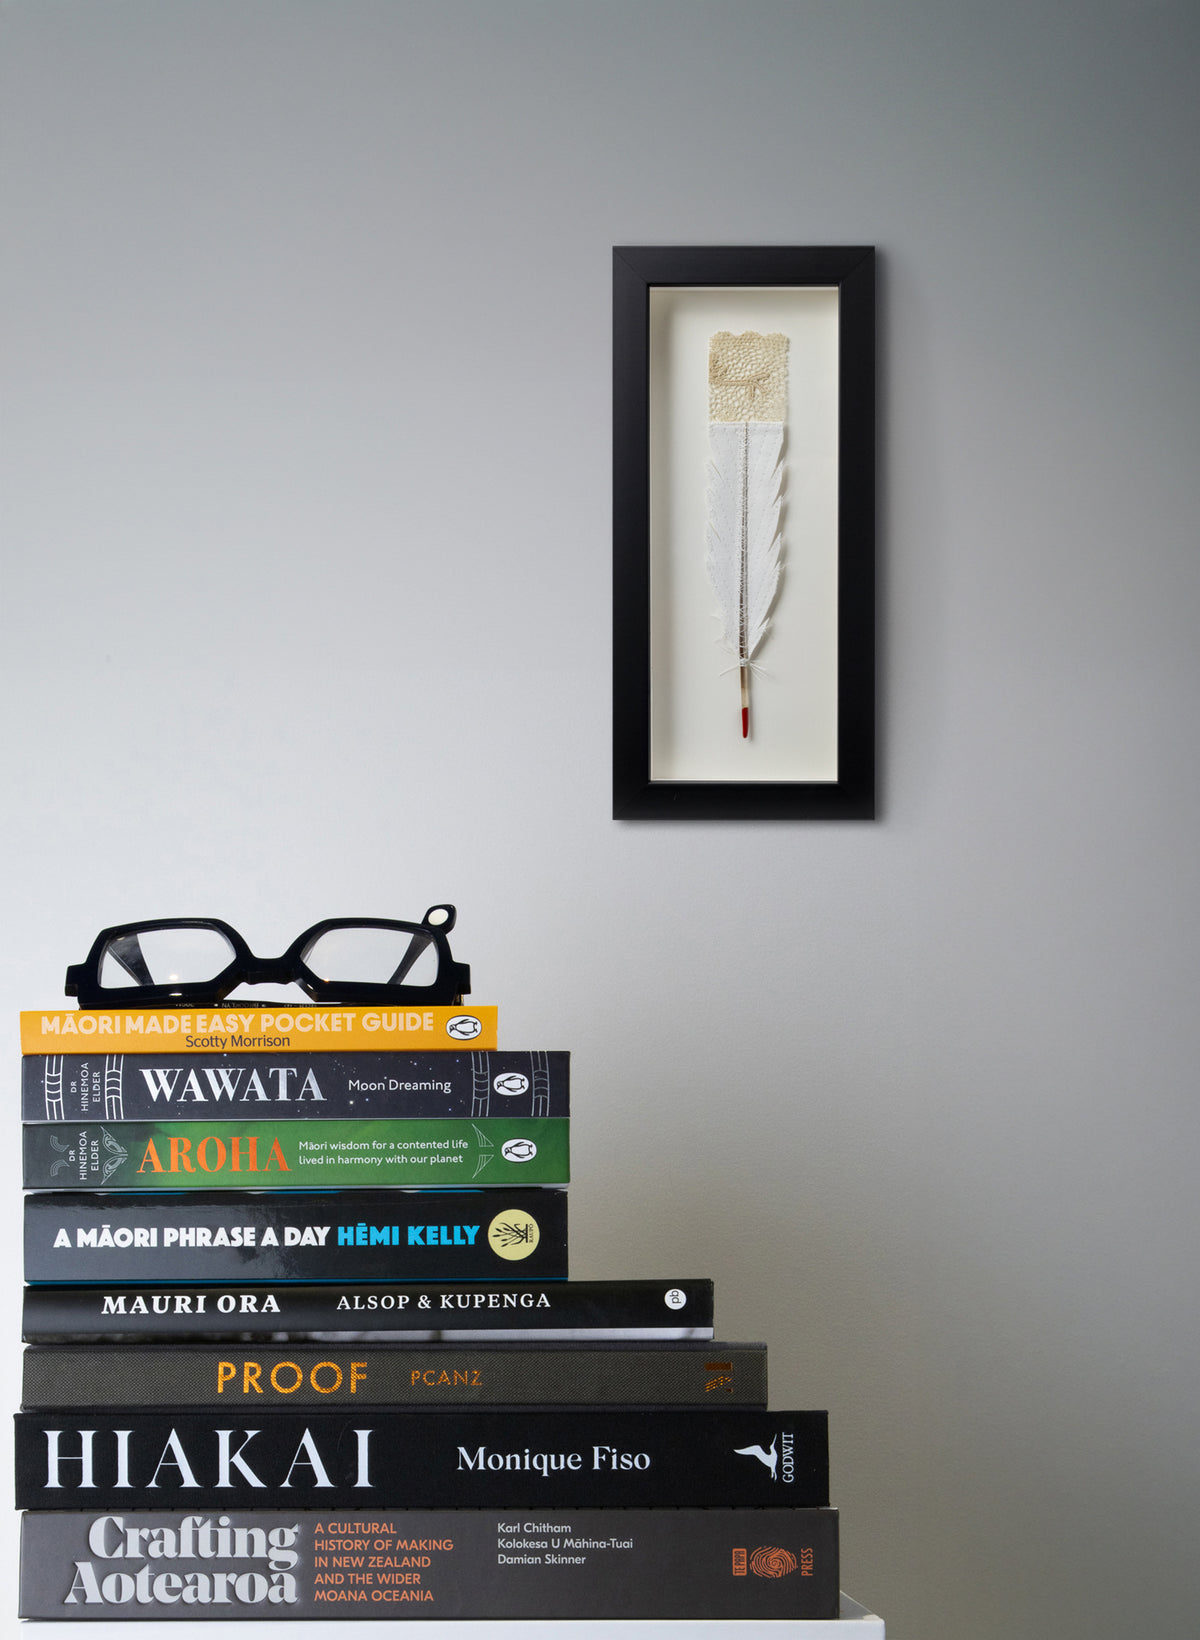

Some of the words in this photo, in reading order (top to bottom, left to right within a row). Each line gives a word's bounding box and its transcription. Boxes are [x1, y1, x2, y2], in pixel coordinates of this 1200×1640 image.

[41, 1012, 121, 1035] MĀORI
[125, 1015, 192, 1034] MADE
[196, 1014, 253, 1033] EASY
[260, 1012, 357, 1033] POCKET
[361, 1011, 434, 1032] GUIDE
[185, 1034, 228, 1050] Scotty
[230, 1034, 291, 1050] Morrison
[70, 1080, 77, 1093] DR
[80, 1062, 89, 1112] HINEMOA
[92, 1071, 101, 1103] ELDER
[140, 1067, 328, 1103] WAWATA
[348, 1079, 385, 1092] Moon
[388, 1079, 452, 1095] Dreaming
[298, 1140, 328, 1151] Māori
[329, 1140, 370, 1151] wisdom
[372, 1139, 388, 1150] for
[388, 1142, 395, 1150] a
[397, 1139, 449, 1150] contented
[451, 1138, 469, 1149] life
[68, 1149, 76, 1162] DR
[79, 1130, 88, 1181] HINEMOA
[90, 1139, 100, 1172] ELDER
[136, 1135, 293, 1174] AROHA
[298, 1155, 324, 1165] lived
[325, 1155, 335, 1165] in
[337, 1155, 384, 1167] harmony
[386, 1154, 407, 1164] with
[409, 1156, 427, 1164] our
[429, 1153, 464, 1166] planet
[52, 1228, 72, 1248] A
[76, 1224, 158, 1248] MĀORI
[163, 1227, 256, 1248] PHRASE
[260, 1226, 280, 1247] A
[284, 1226, 332, 1247] DAY
[337, 1222, 400, 1246] HĒMI
[407, 1225, 481, 1246] KELLY
[101, 1295, 207, 1315] MAURI
[216, 1294, 281, 1314] ORA
[336, 1295, 410, 1310] ALSOP
[417, 1294, 432, 1310] &
[439, 1293, 551, 1309] KUPENGA
[216, 1361, 368, 1394] PROOF
[410, 1370, 483, 1387] PCANZ
[42, 1427, 374, 1489] HIAKAI
[456, 1446, 582, 1477] Monique
[592, 1446, 651, 1471] Fiso
[781, 1432, 795, 1483] GODWIT
[314, 1522, 325, 1535] A
[327, 1522, 398, 1535] CULTURAL
[497, 1522, 521, 1534] Karl
[523, 1522, 572, 1534] Chitham
[89, 1515, 300, 1571] Crafting
[314, 1539, 372, 1552] HISTORY
[374, 1539, 393, 1551] OF
[395, 1538, 454, 1551] MAKING
[497, 1538, 548, 1549] Kolokesa
[551, 1538, 561, 1549] U
[563, 1537, 633, 1549] Māhina-Tuai
[314, 1556, 329, 1568] IN
[332, 1556, 365, 1568] NEW
[367, 1556, 432, 1568] ZEALAND
[497, 1553, 542, 1565] Damian
[544, 1553, 587, 1565] Skinner
[801, 1548, 813, 1577] PRESS
[64, 1561, 299, 1604] Aotearoa
[314, 1572, 345, 1585] AND
[347, 1572, 374, 1585] THE
[376, 1572, 421, 1585] WIDER
[314, 1589, 368, 1602] MOANA
[370, 1589, 434, 1602] OCEANIA
